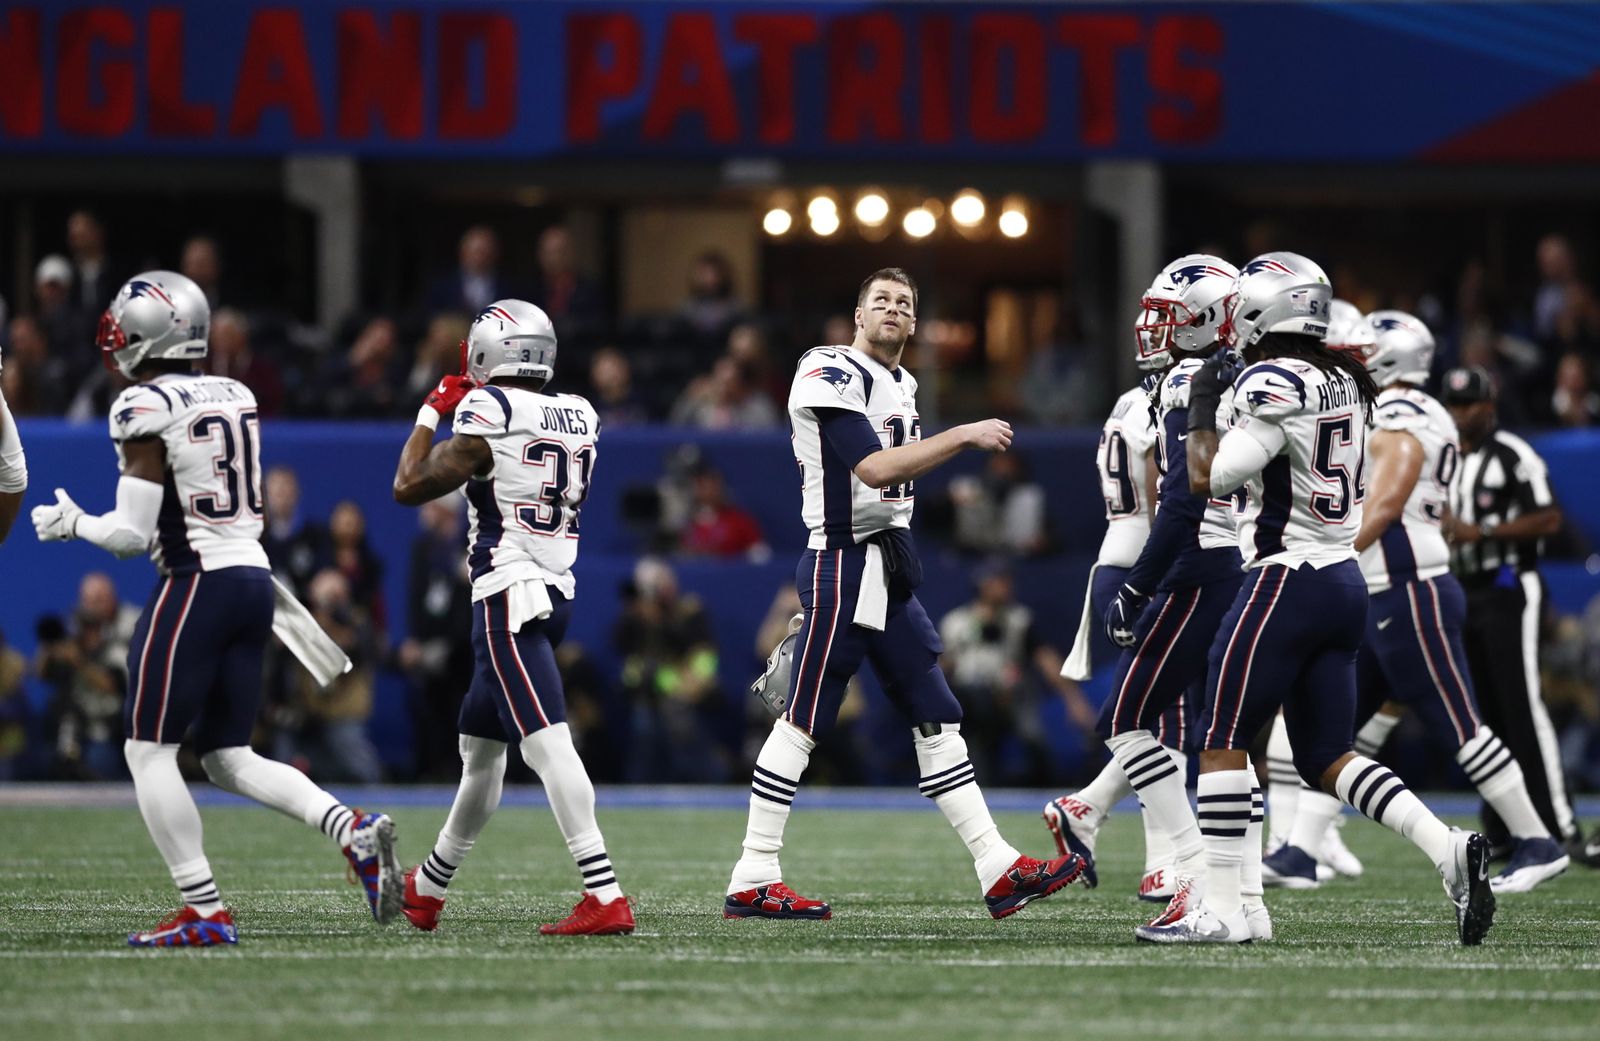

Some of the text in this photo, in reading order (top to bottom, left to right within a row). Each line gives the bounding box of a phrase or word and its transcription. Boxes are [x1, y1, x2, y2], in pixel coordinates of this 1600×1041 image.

[564, 12, 1226, 143] PATRIOTS
[1310, 300, 1328, 317] 54
[540, 405, 588, 436] JONES
[514, 437, 592, 537] 31
